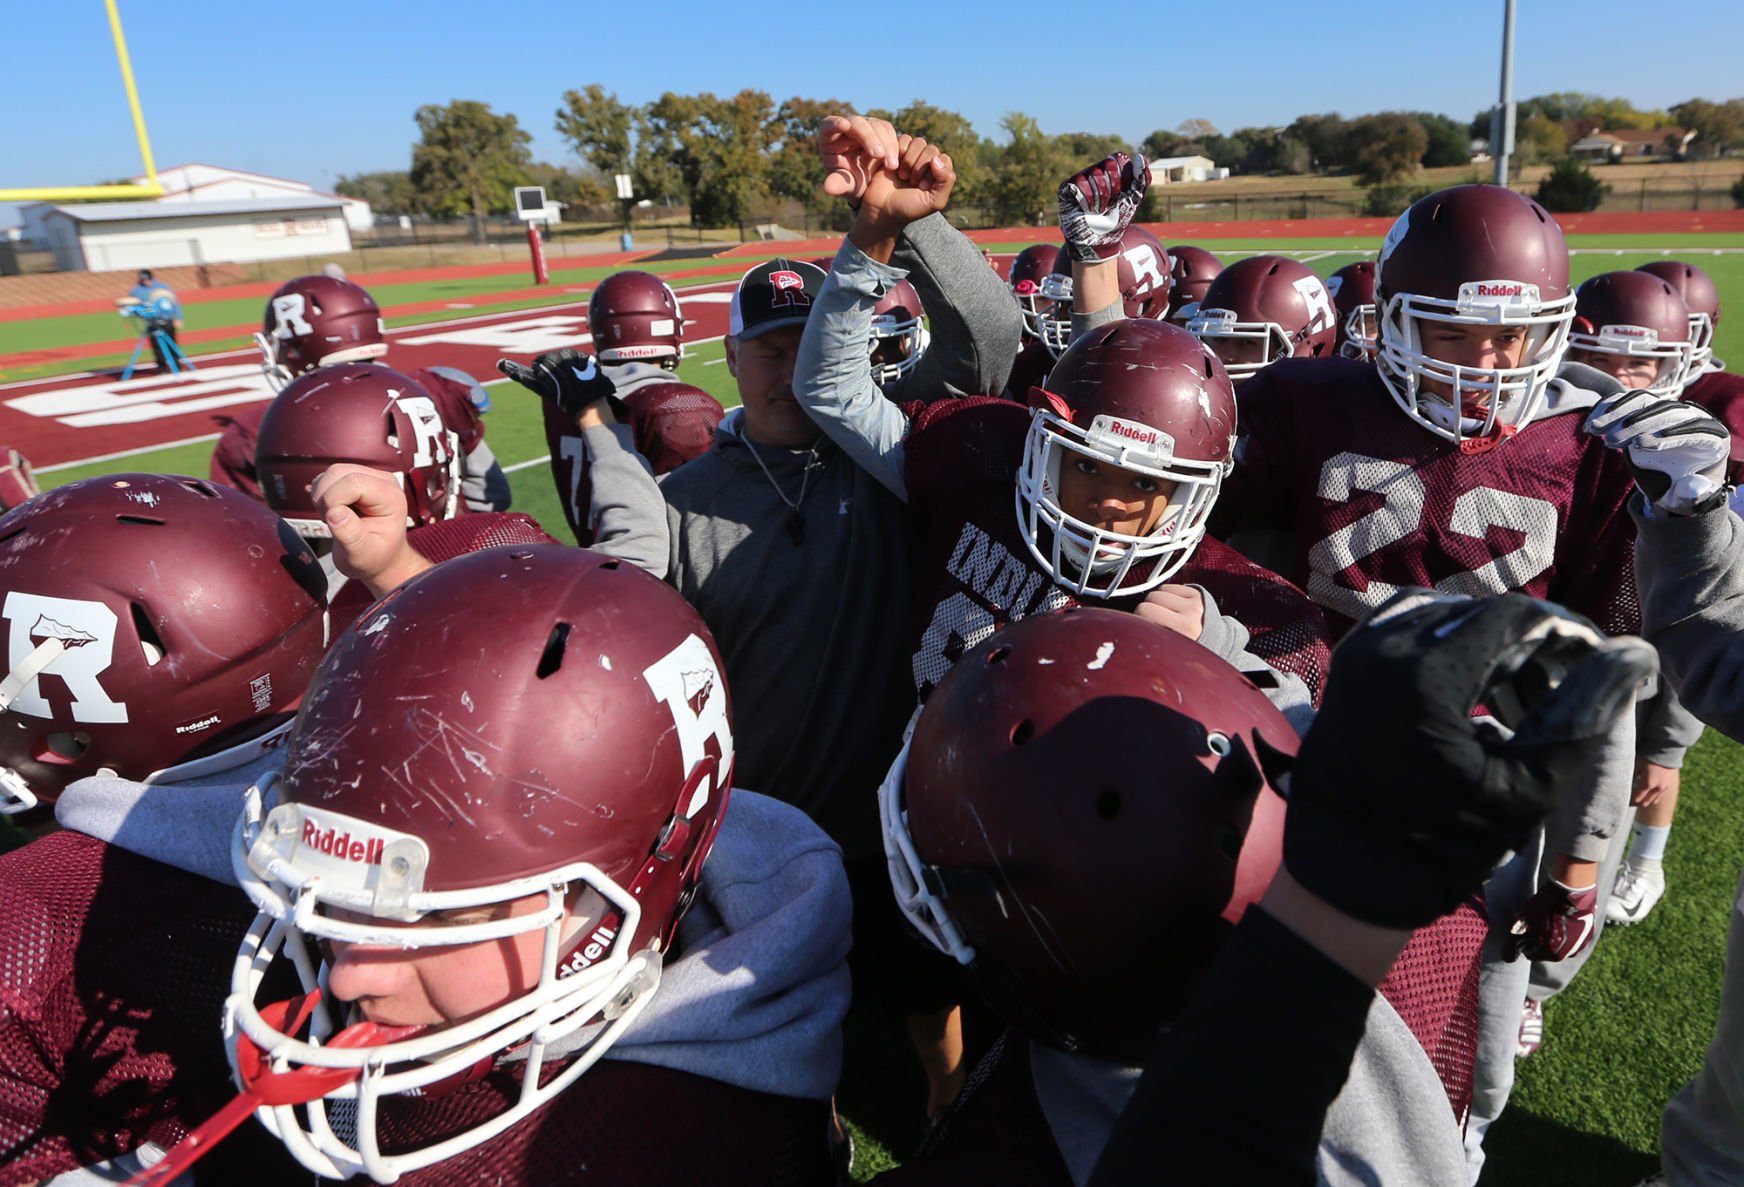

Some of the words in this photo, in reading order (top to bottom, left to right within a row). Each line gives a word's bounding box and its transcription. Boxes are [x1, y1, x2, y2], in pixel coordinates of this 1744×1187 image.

[769, 271, 810, 308] R
[1122, 243, 1165, 296] R
[1477, 285, 1522, 297] Riddell
[272, 293, 314, 340] R
[1292, 275, 1336, 335] R
[396, 397, 447, 468] R
[1110, 420, 1158, 445] Riddell
[1307, 451, 1559, 620] 22
[1, 590, 129, 724] R
[175, 715, 221, 734] Riddell
[642, 632, 734, 818] R
[302, 817, 384, 866] Riddell
[559, 926, 618, 978] ddell
